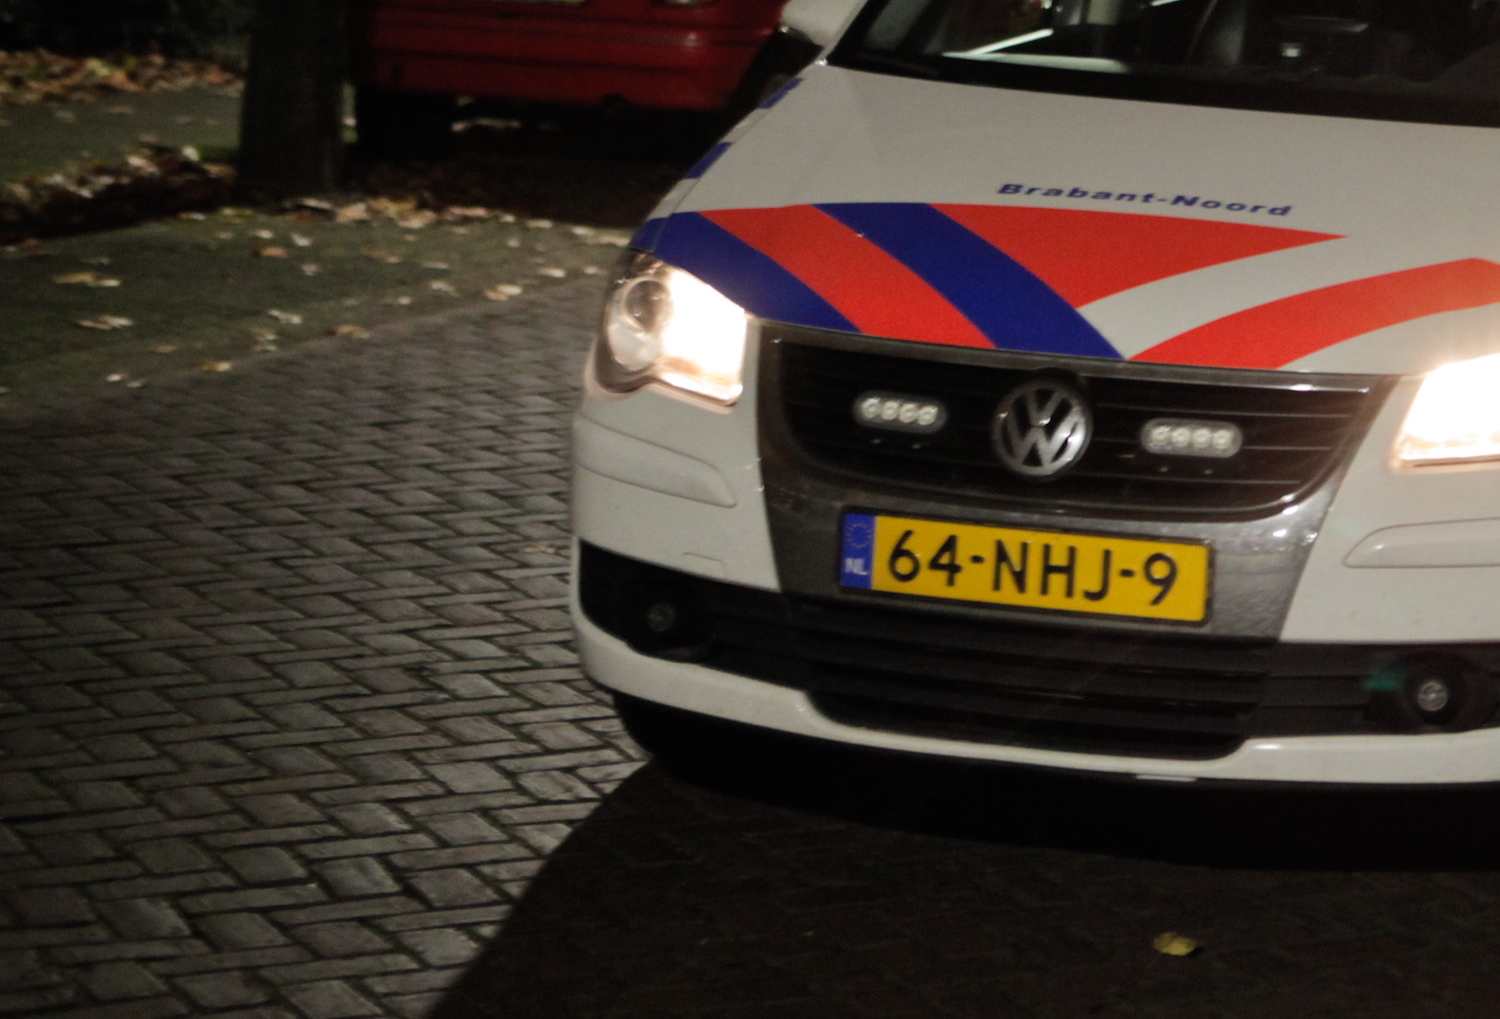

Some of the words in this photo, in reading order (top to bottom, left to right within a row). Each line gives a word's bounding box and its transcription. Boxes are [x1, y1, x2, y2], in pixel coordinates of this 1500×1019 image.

[997, 182, 1293, 217] Brabant-Noord
[845, 558, 868, 577] NL
[888, 530, 1178, 606] 64-NHJ-9
